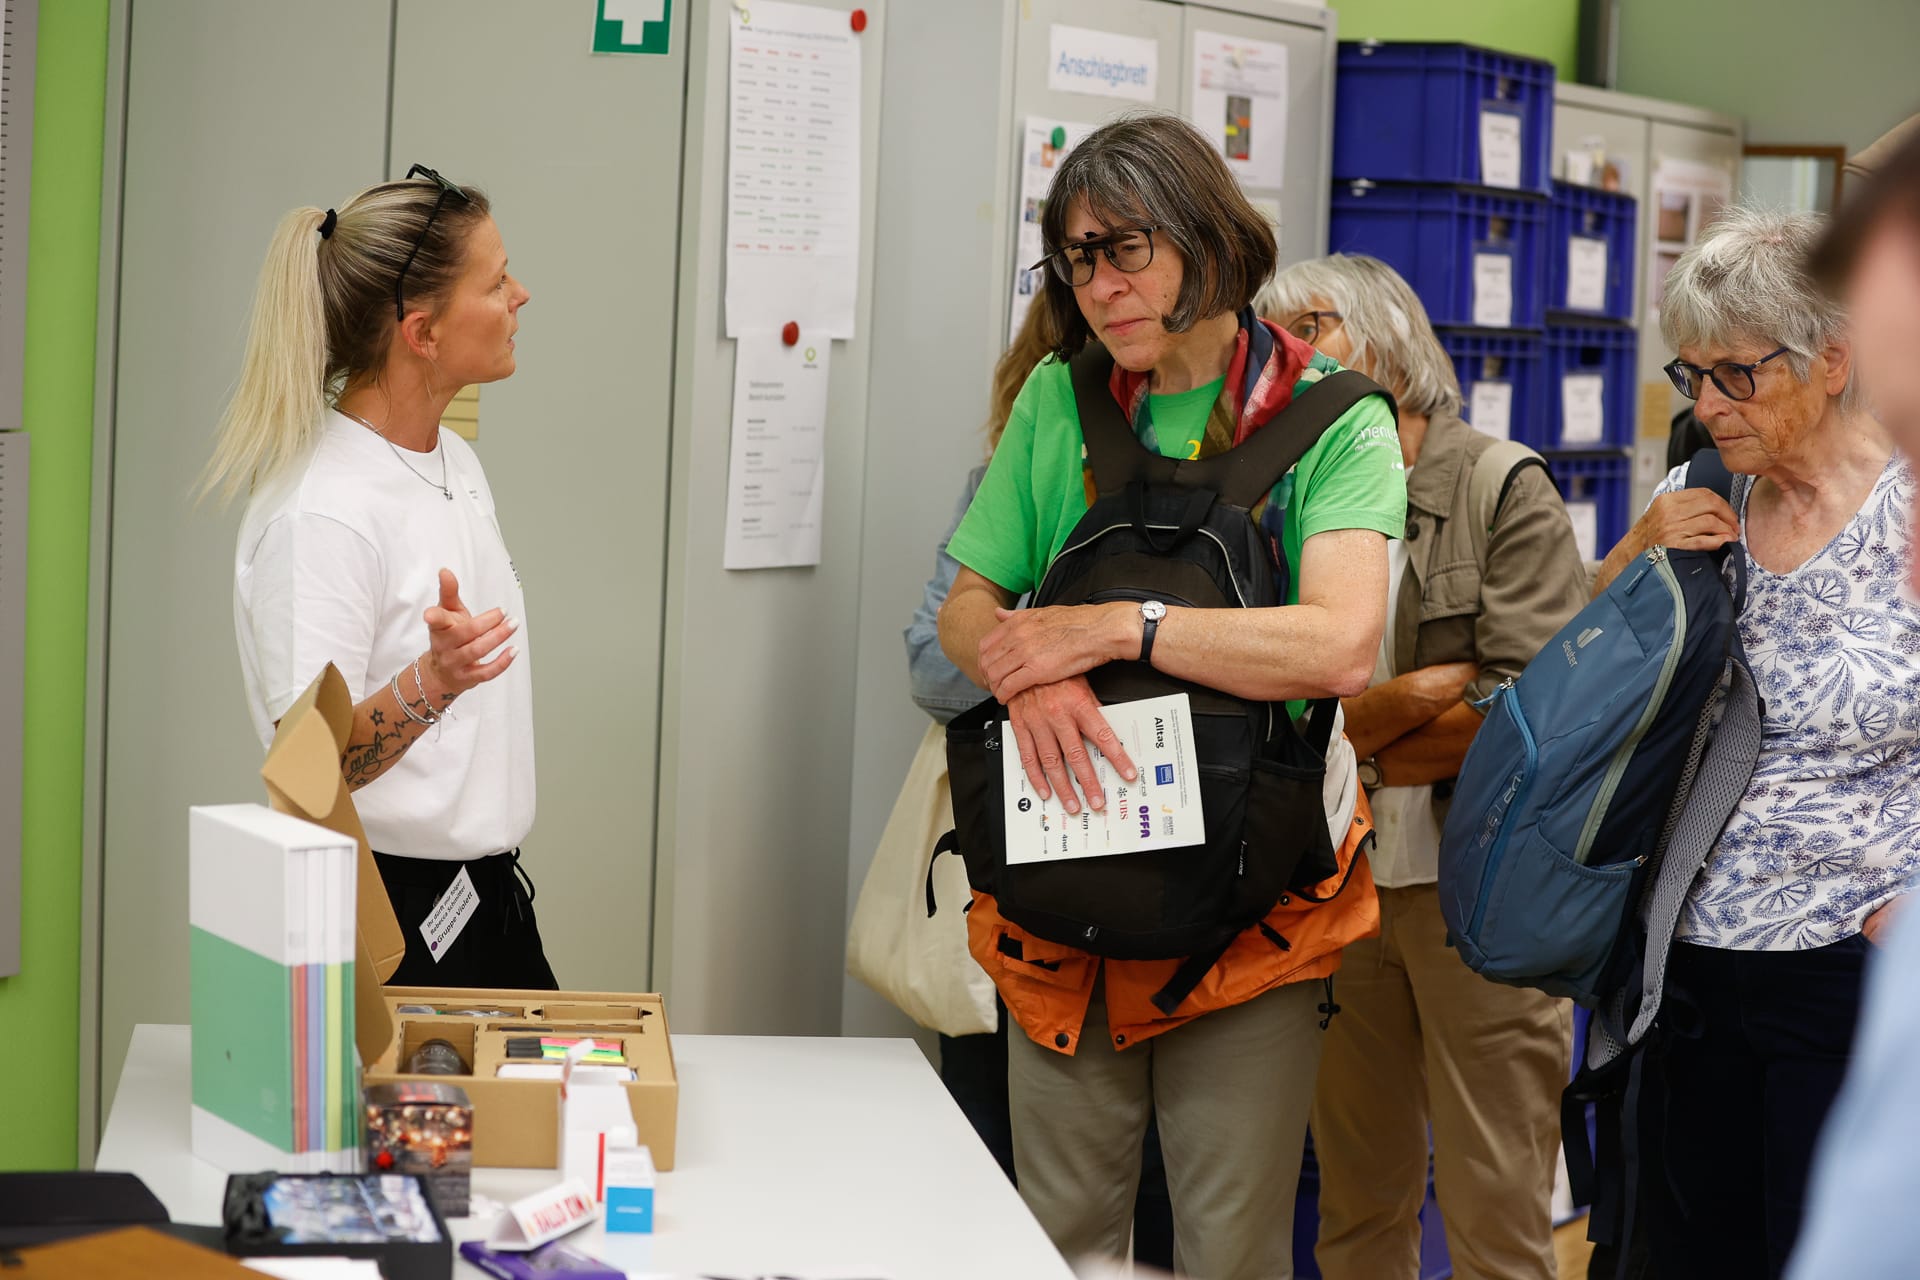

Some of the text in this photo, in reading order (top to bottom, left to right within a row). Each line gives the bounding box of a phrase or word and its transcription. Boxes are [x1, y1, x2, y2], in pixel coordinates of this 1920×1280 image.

[1056, 50, 1147, 87] Anschlagbrett
[1563, 640, 1577, 668] deuter
[1154, 717, 1164, 749] Alltag
[1119, 799, 1128, 820] UBS
[1139, 805, 1150, 838] OFFA
[450, 878, 462, 897] folgen
[430, 912, 448, 935] Rebecca
[437, 891, 473, 943] Gruppe Violett
